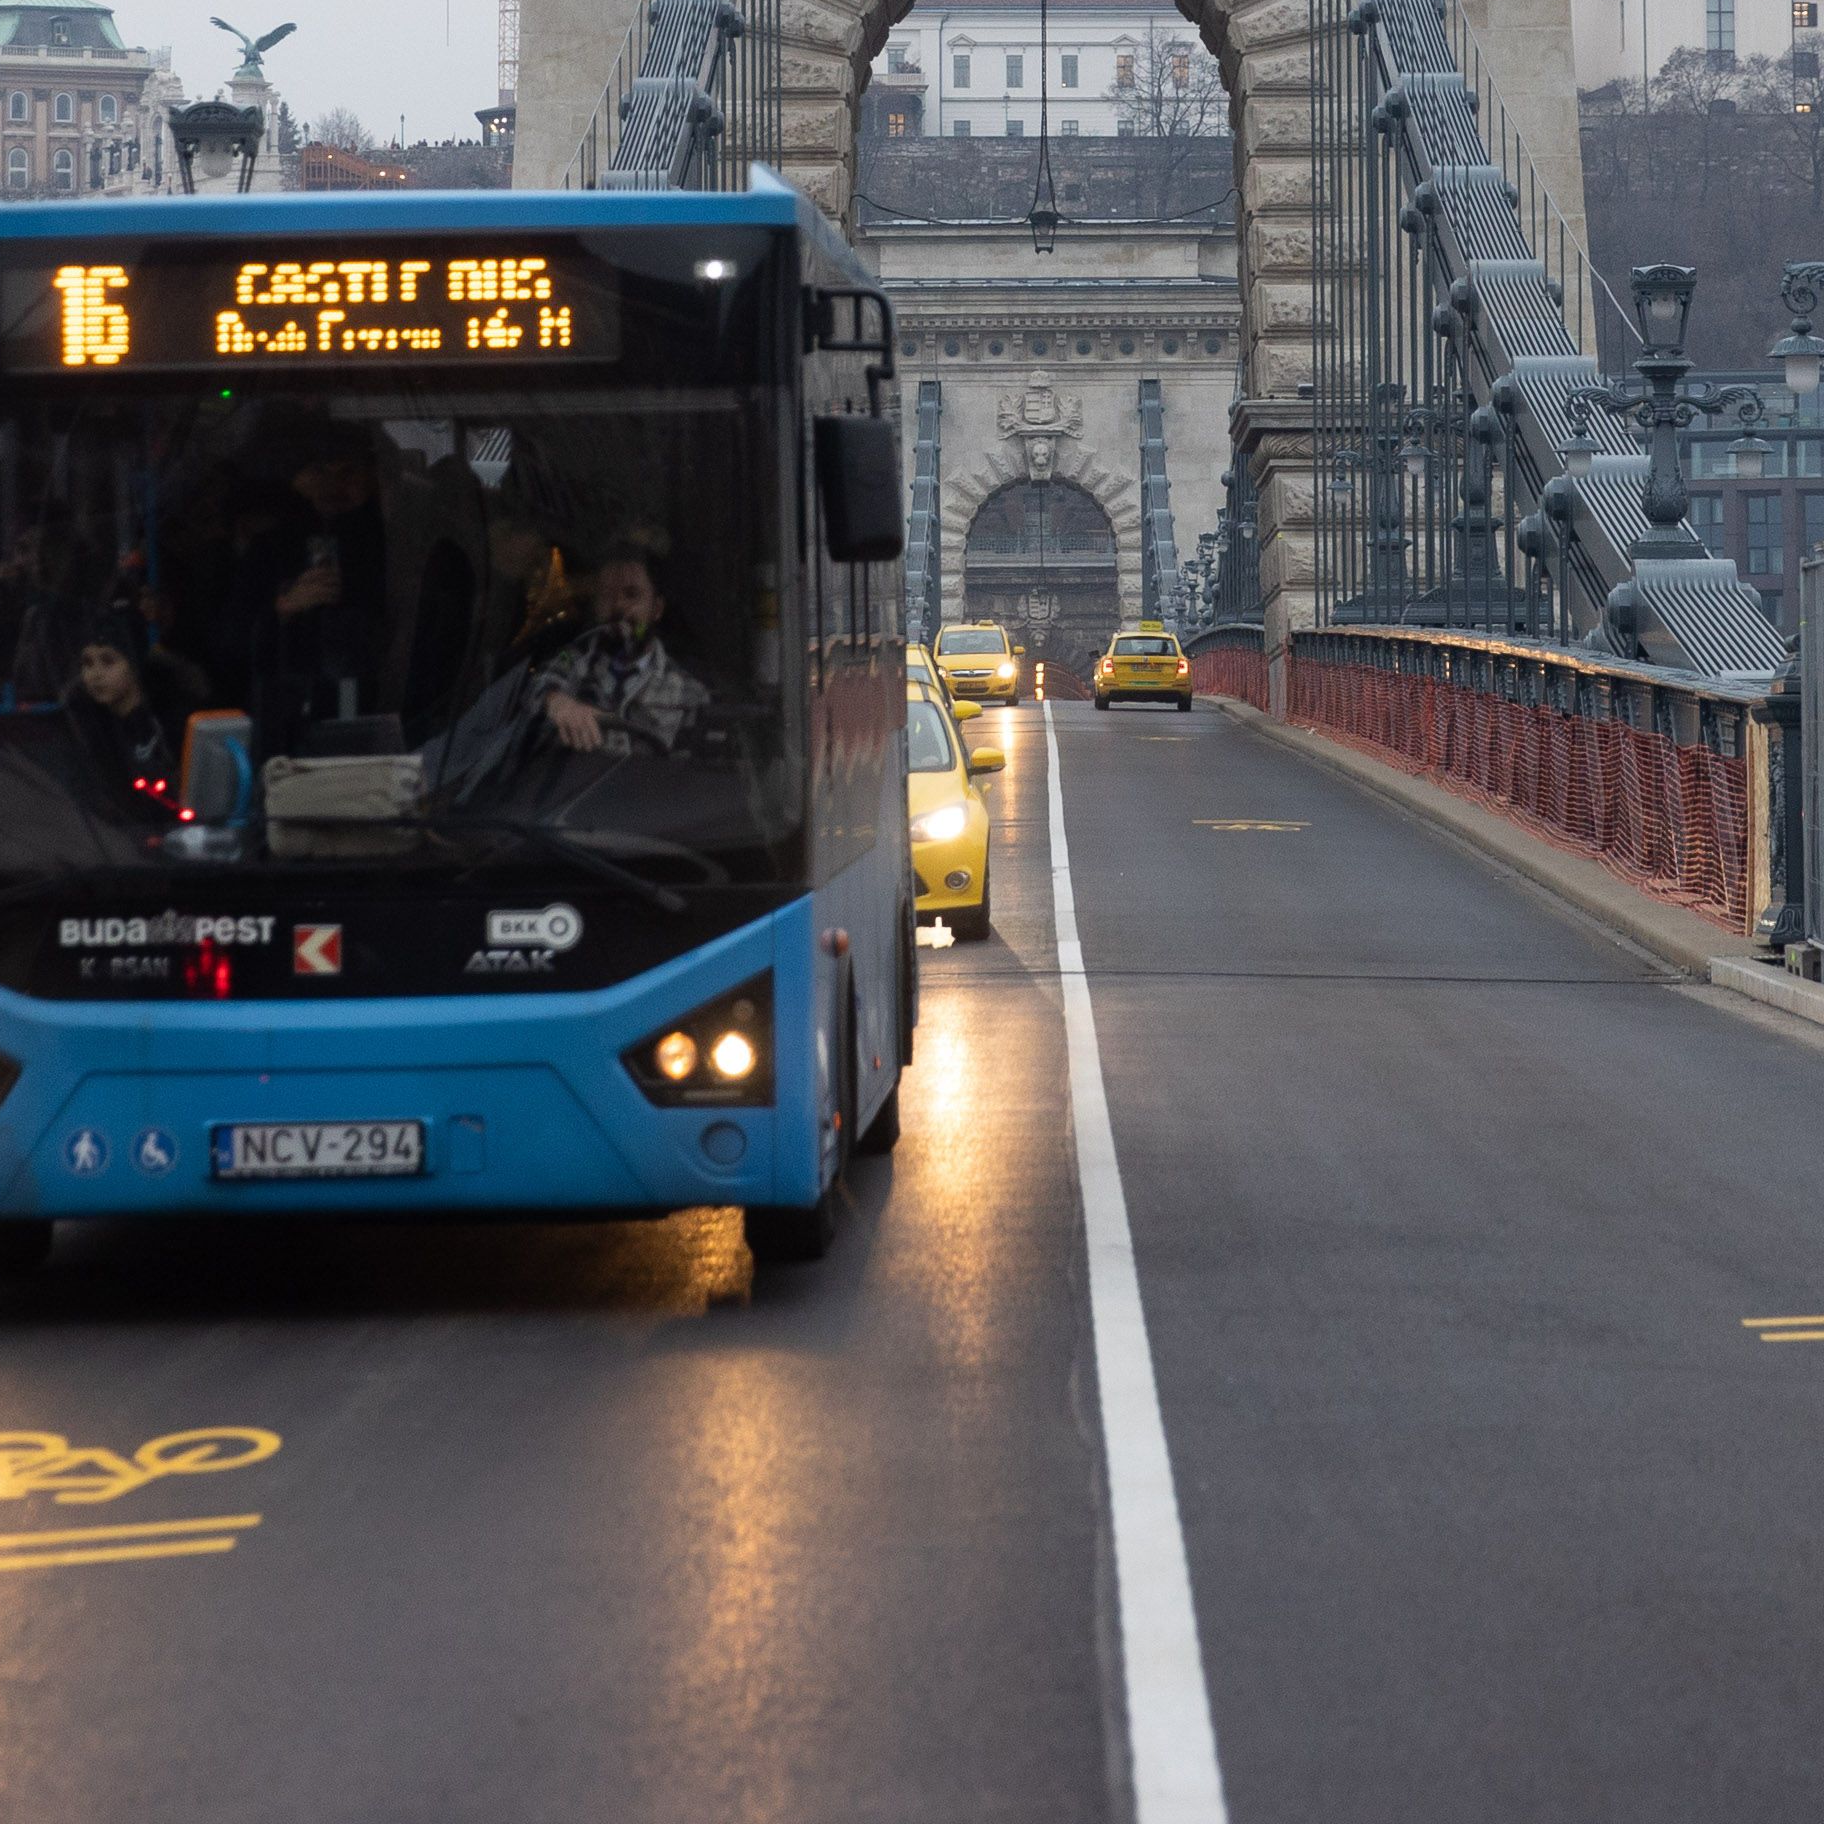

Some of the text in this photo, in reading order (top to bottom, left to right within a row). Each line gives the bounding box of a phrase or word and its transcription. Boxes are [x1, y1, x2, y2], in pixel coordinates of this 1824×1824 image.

[500, 920, 538, 934] BKK
[464, 950, 554, 973] ATAK
[242, 1127, 412, 1164] NCV-294
